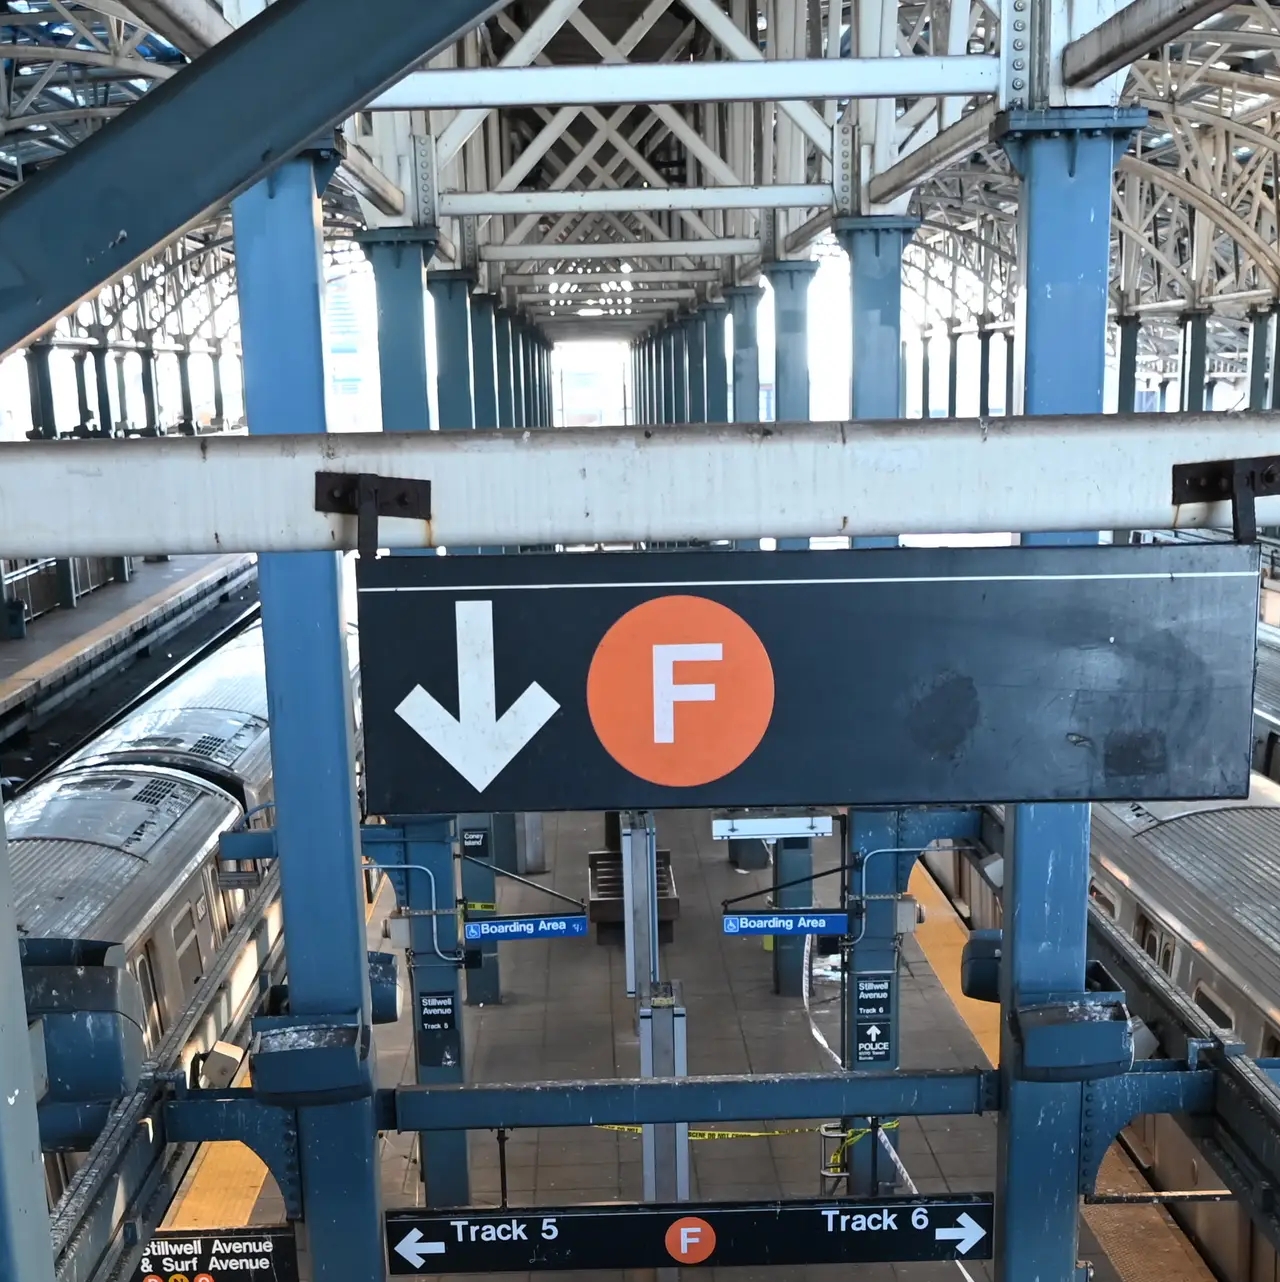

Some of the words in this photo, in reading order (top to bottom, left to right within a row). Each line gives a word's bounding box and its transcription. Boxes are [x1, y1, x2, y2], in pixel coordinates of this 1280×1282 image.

[653, 643, 723, 744] F
[464, 833, 484, 841] Coney
[481, 922, 534, 934] Boarding
[538, 920, 566, 931] Area
[740, 917, 793, 930] Boarding
[797, 917, 826, 928] Area
[859, 982, 889, 990] Stillwell
[859, 991, 888, 999] Avenue
[422, 998, 452, 1006] Stillwell
[423, 1007, 452, 1015] Avenue
[859, 1042, 889, 1051] POLICE
[822, 1209, 897, 1232] Track
[911, 1207, 929, 1230] 6
[450, 1218, 528, 1242] Track
[541, 1218, 559, 1240] 5
[212, 1239, 273, 1254] Avenue
[680, 1228, 701, 1254] F
[140, 1257, 153, 1273] &
[162, 1257, 198, 1272] Surf
[208, 1256, 270, 1271] Avenue
